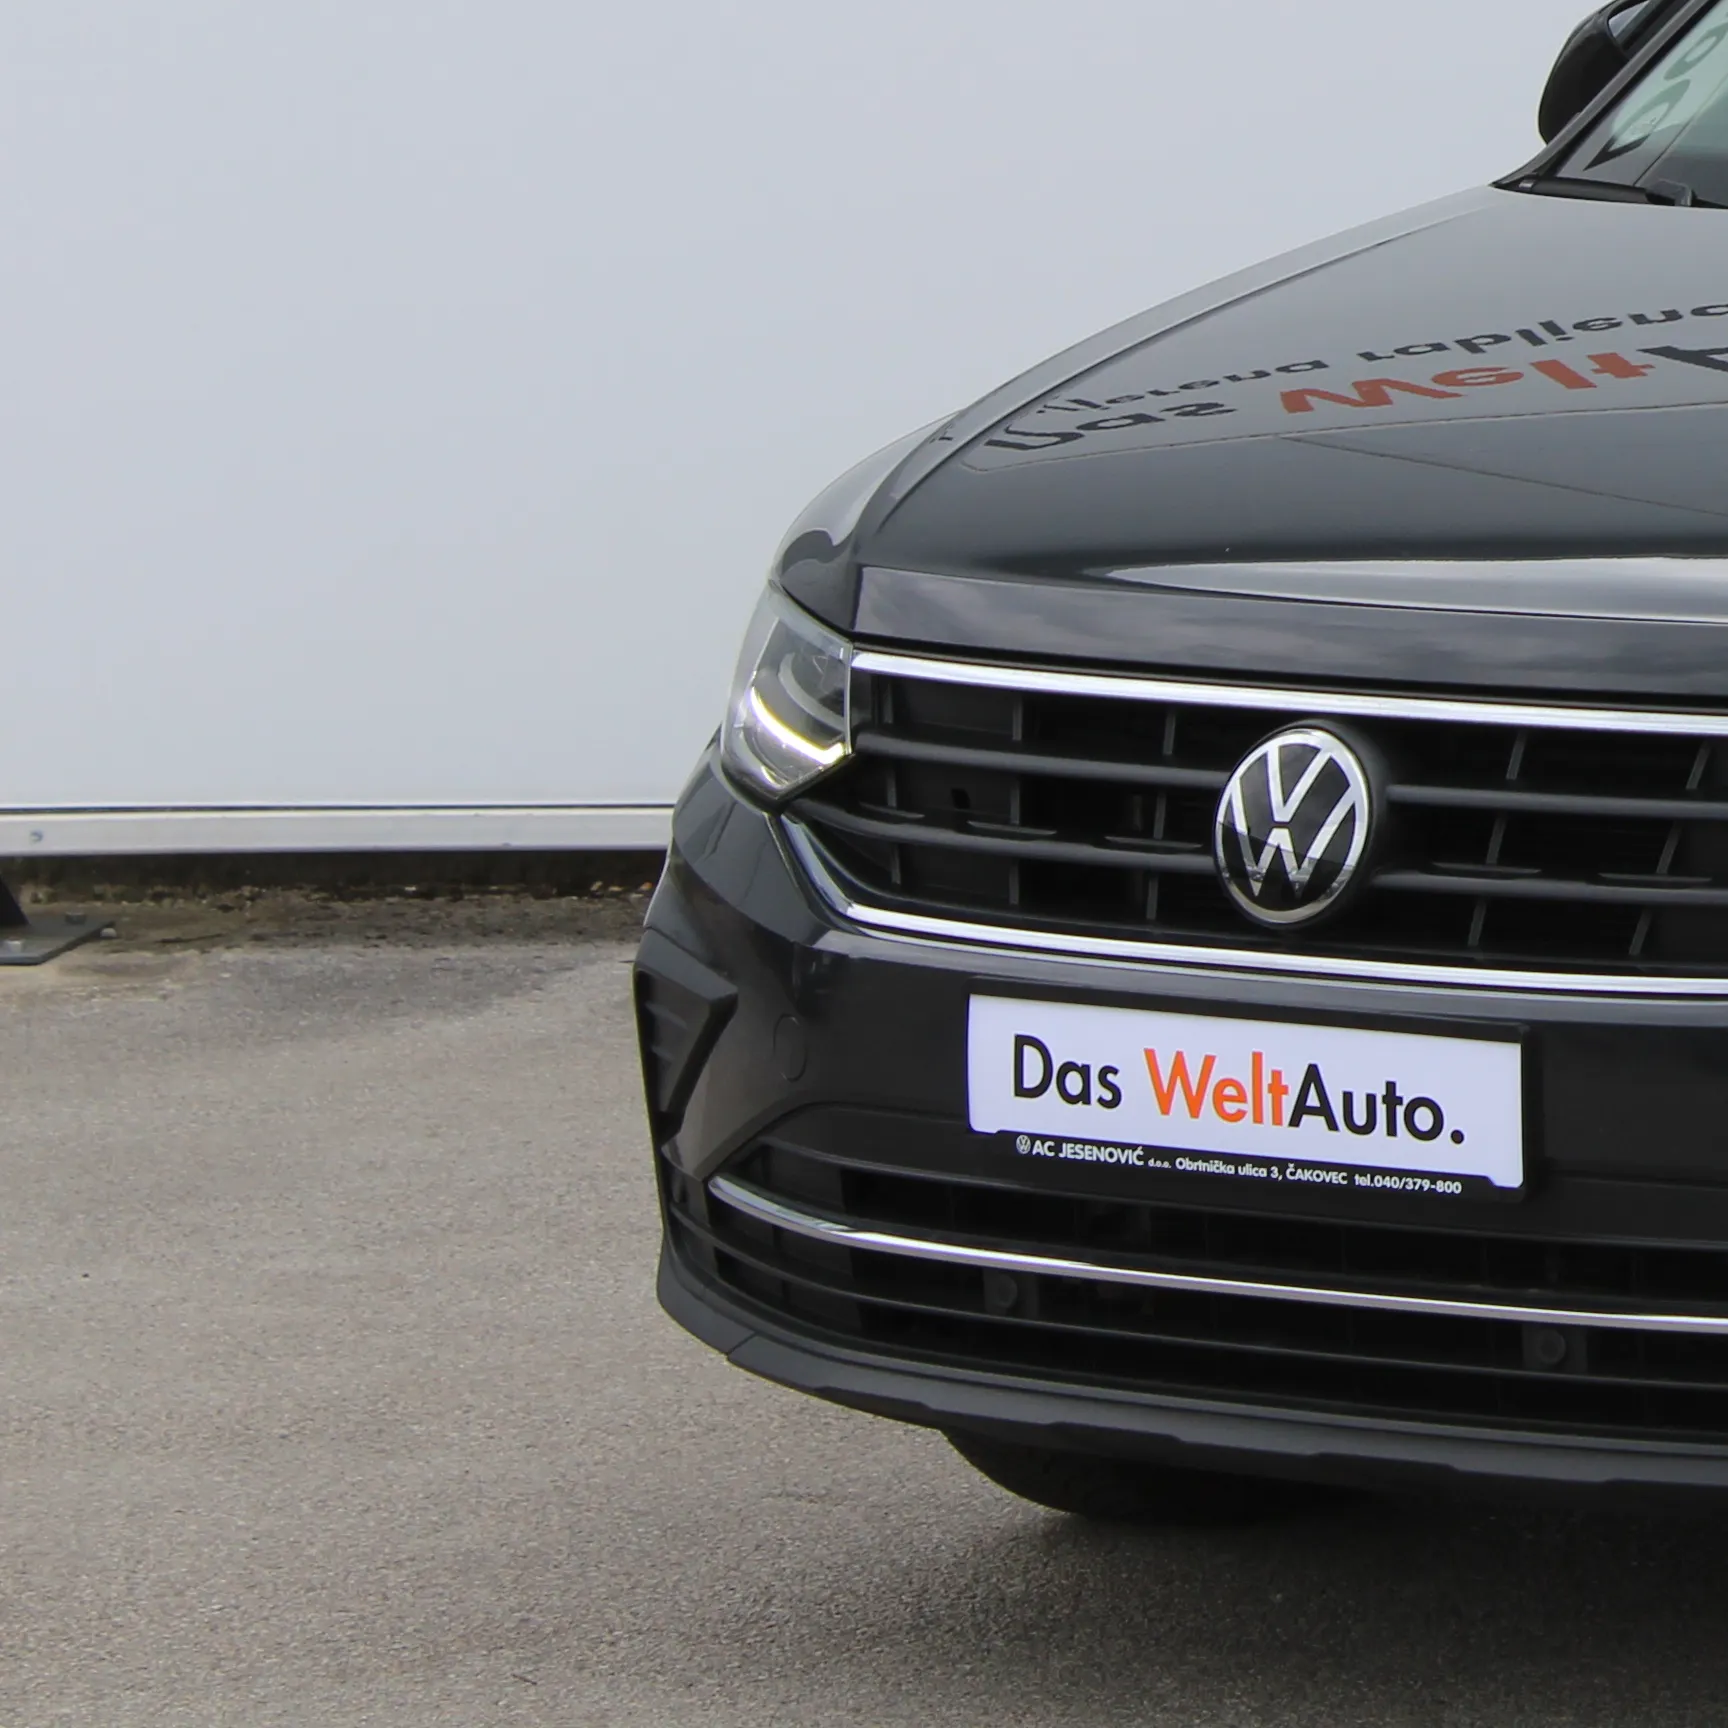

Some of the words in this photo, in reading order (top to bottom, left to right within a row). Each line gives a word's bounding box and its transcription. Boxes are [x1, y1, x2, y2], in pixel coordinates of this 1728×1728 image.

[1013, 1033, 1123, 1110] Das
[1144, 1048, 1465, 1145] WeltAuto.
[1032, 1139, 1056, 1157] AC
[1058, 1142, 1144, 1166] JESENOVIĆ
[1148, 1158, 1172, 1169] d.o.o.
[1238, 1163, 1268, 1178] ulica
[1270, 1166, 1283, 1181] 3,
[1286, 1163, 1348, 1185] ČAKOVEC
